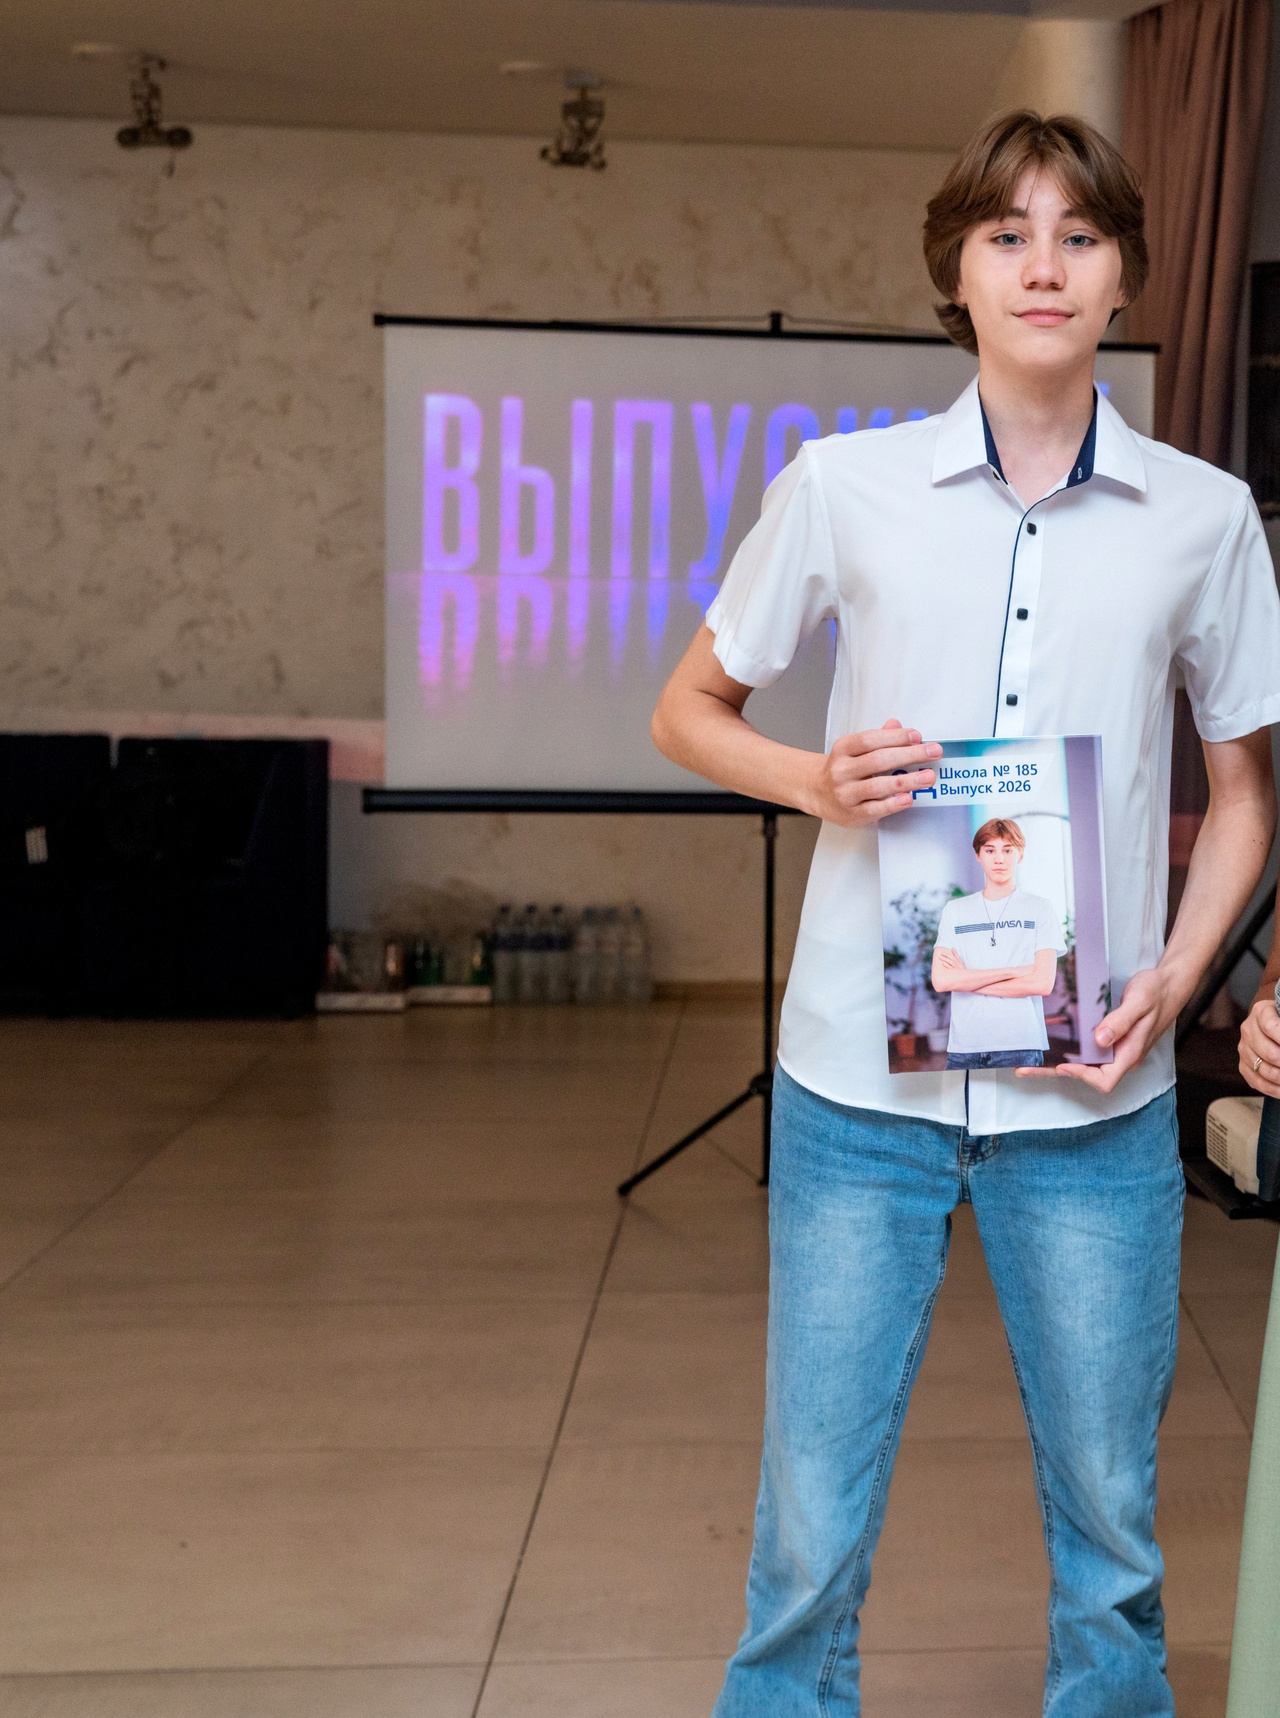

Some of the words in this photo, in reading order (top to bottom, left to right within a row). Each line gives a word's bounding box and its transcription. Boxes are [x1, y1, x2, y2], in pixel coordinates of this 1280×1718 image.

[939, 767, 987, 779] Школа
[993, 765, 1010, 777] №
[1015, 764, 1038, 776] 185
[940, 784, 993, 797] Выпуск
[998, 780, 1031, 792] 2026
[996, 920, 1022, 929] NASA
